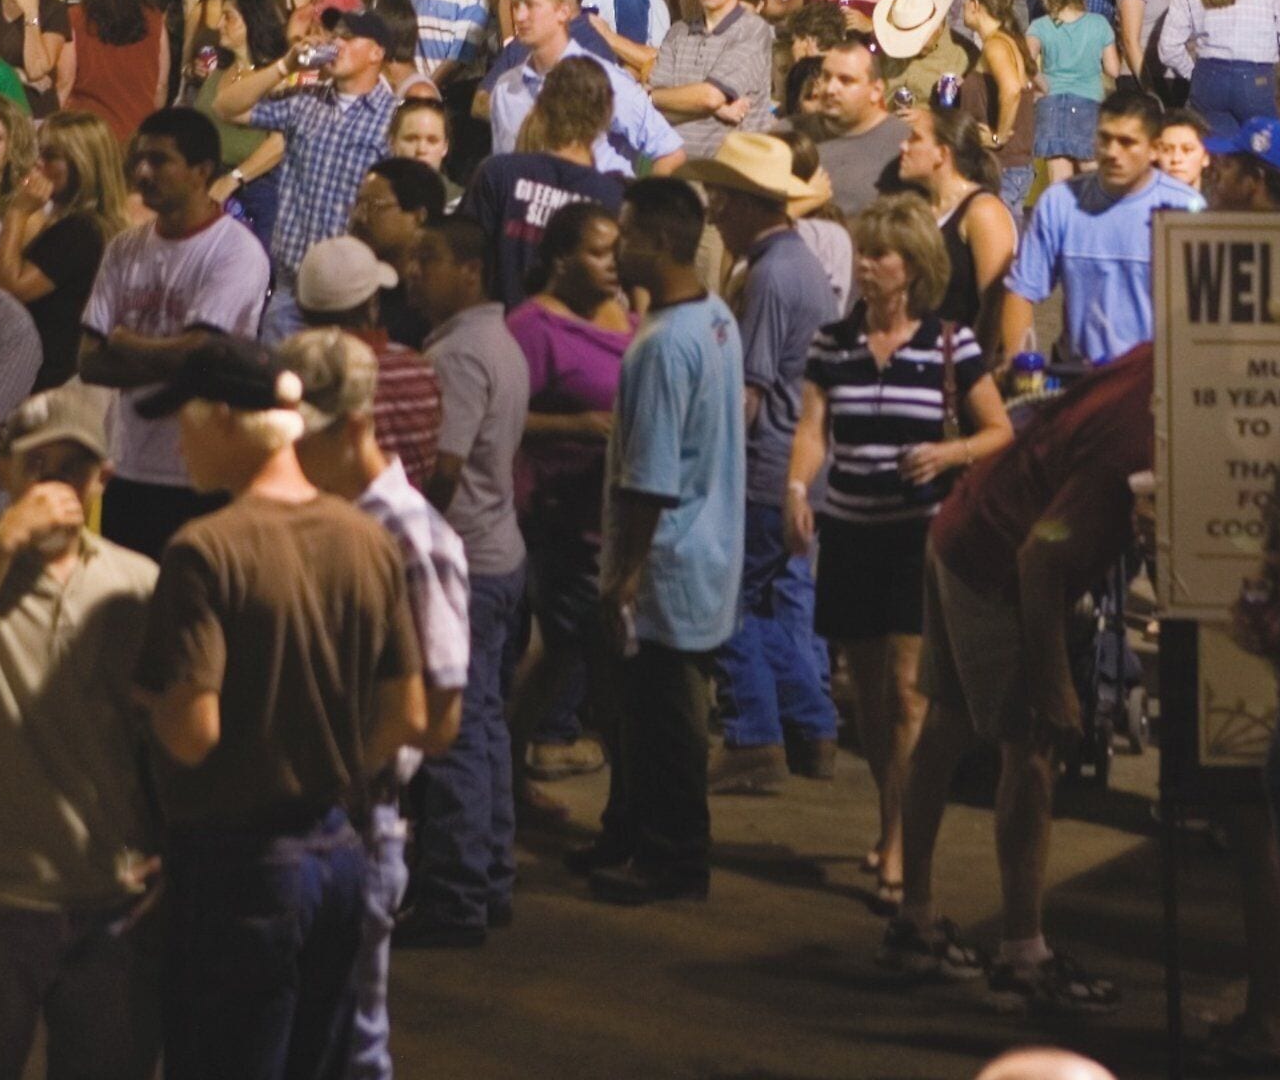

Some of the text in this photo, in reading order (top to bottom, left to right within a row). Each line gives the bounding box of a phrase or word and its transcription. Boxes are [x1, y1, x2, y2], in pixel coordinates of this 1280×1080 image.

[1192, 389, 1217, 407] 18
[1235, 419, 1271, 437] TO
[1225, 460, 1276, 479] THA
[1206, 522, 1266, 539] COO
